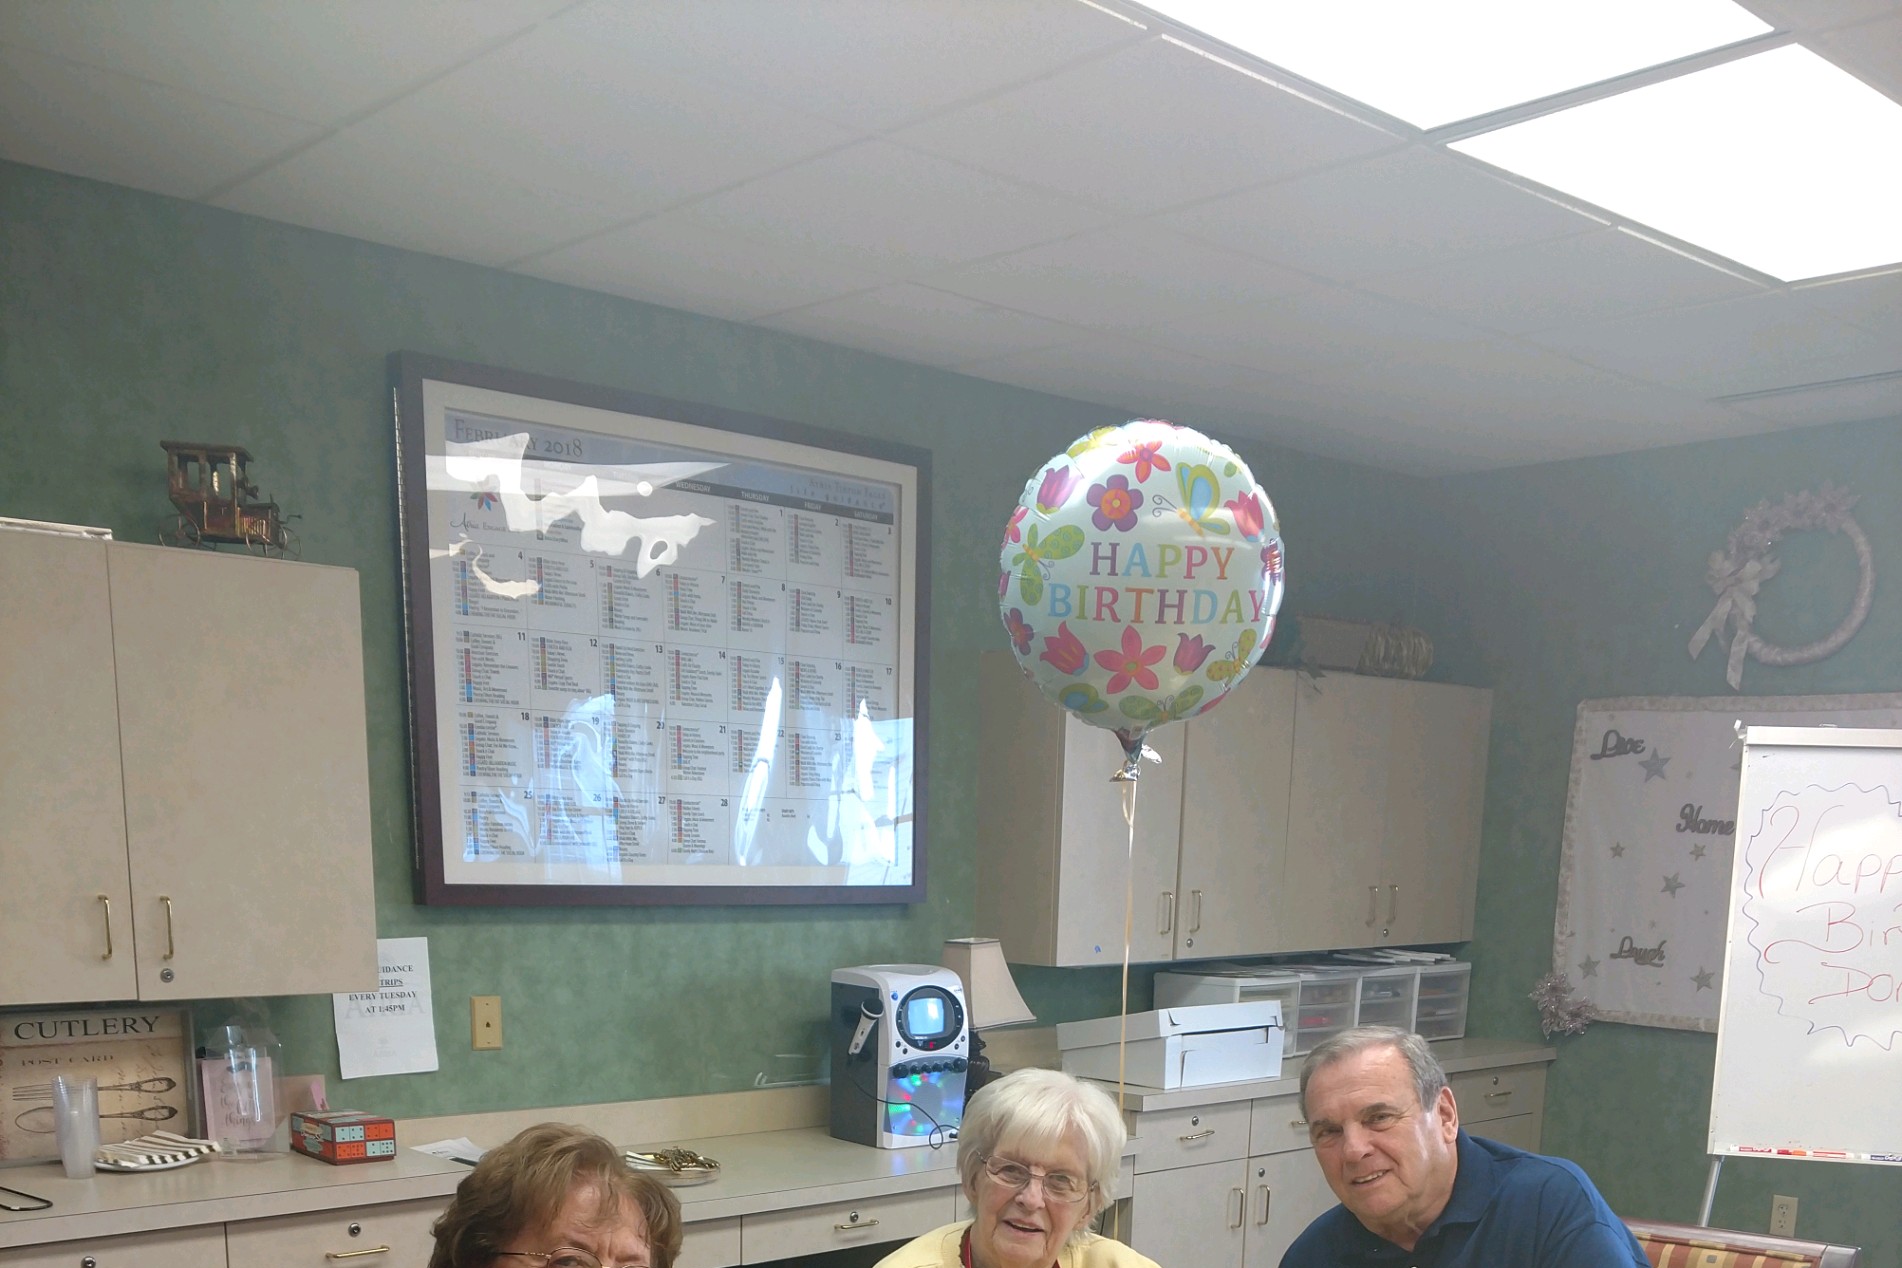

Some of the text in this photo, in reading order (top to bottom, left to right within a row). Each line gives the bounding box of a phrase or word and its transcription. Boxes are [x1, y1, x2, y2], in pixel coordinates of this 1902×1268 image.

[544, 438, 583, 458] 2018
[675, 481, 878, 521] WEDNESDAY THURSDAY FRIDAY SATURDAY
[589, 560, 595, 569] 5
[1089, 542, 1235, 580] HAPPY
[885, 598, 892, 606] 10
[1048, 582, 1266, 625] BIRTHDAY
[517, 632, 526, 641] 11
[589, 639, 598, 648] 12
[655, 645, 663, 654] 13
[718, 651, 726, 660] 14
[778, 657, 785, 665] 15
[835, 662, 842, 670] 16
[521, 712, 530, 721] 18
[591, 716, 600, 725] 19
[719, 725, 726, 734] 21
[835, 733, 841, 741] 23
[1590, 729, 1646, 761] Live
[524, 790, 533, 799] 25
[593, 793, 601, 802] 26
[658, 796, 666, 805] 27
[720, 798, 728, 807] 28
[1675, 803, 1735, 836] Home
[1764, 901, 1902, 965] Bir
[1609, 935, 1667, 968] Laugh
[380, 978, 403, 988] TRIPS
[349, 990, 417, 1001] EVERY TUESDAY
[365, 1004, 405, 1014] AT 1:45PM
[14, 1015, 161, 1040] CUTLERY
